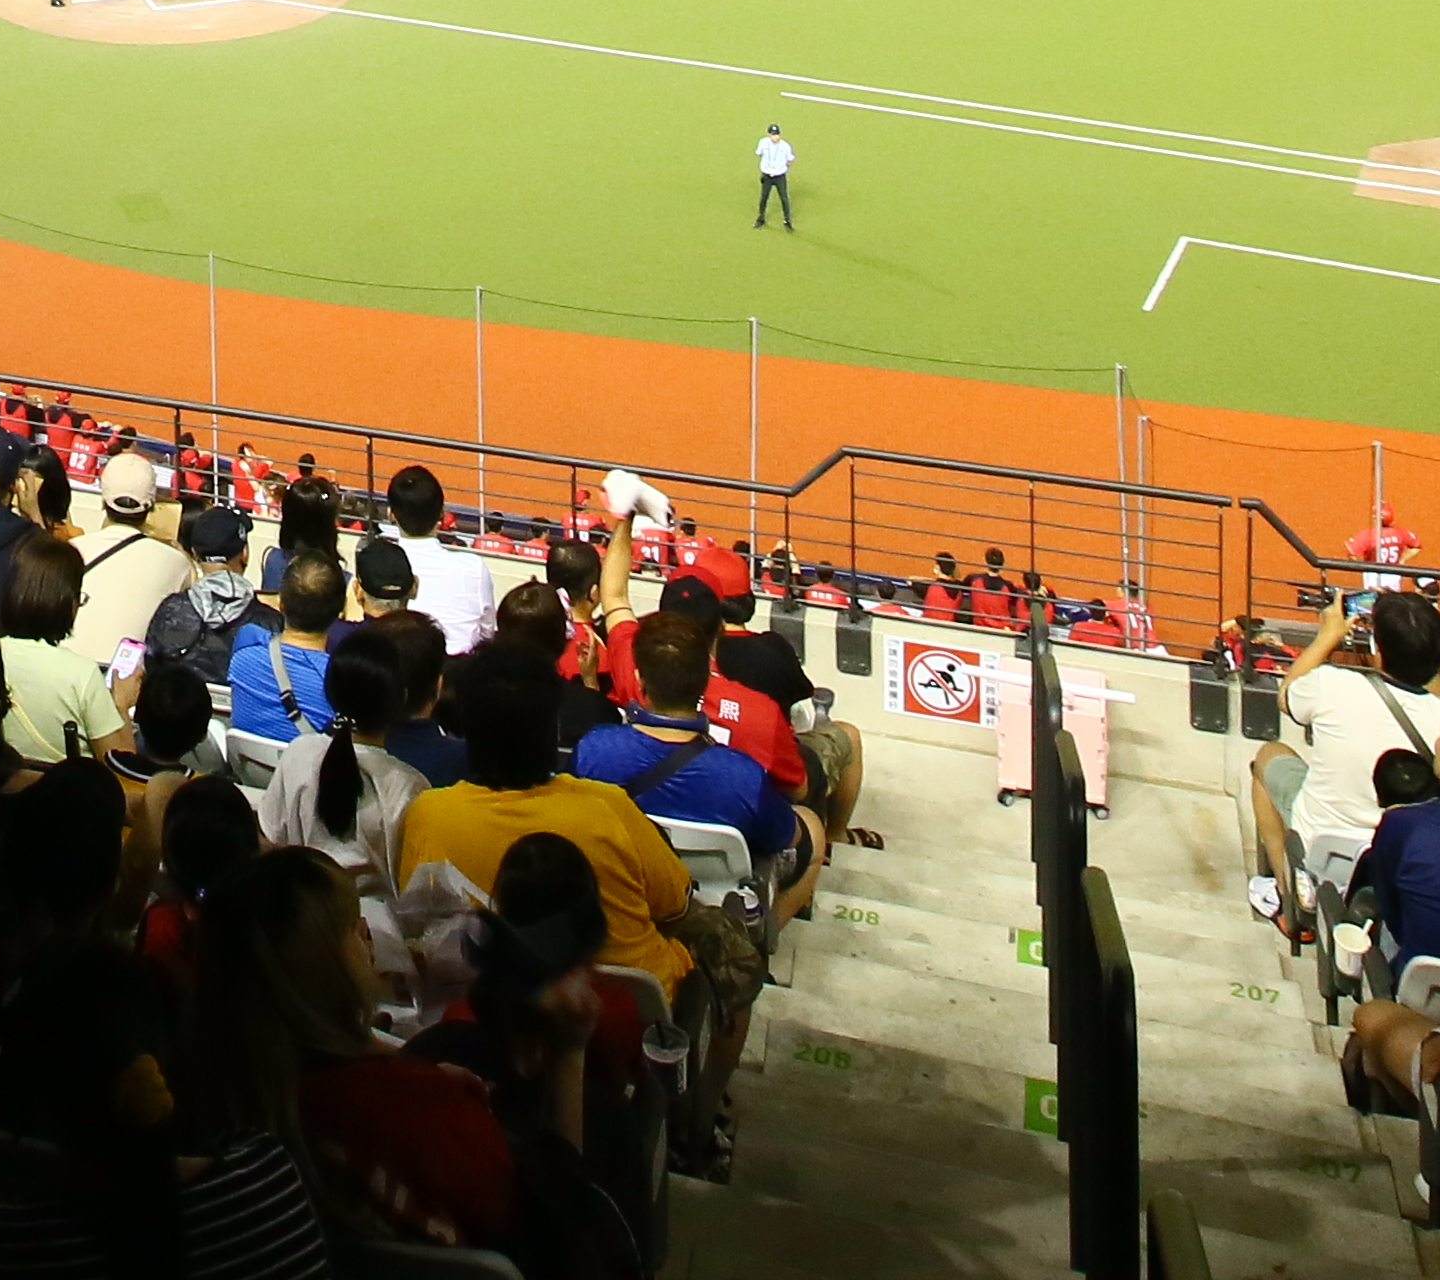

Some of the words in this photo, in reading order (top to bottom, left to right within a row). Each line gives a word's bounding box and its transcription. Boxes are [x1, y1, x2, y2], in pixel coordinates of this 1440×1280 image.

[833, 904, 880, 926] 208
[1229, 981, 1280, 1004] 207
[794, 1043, 852, 1069] 208
